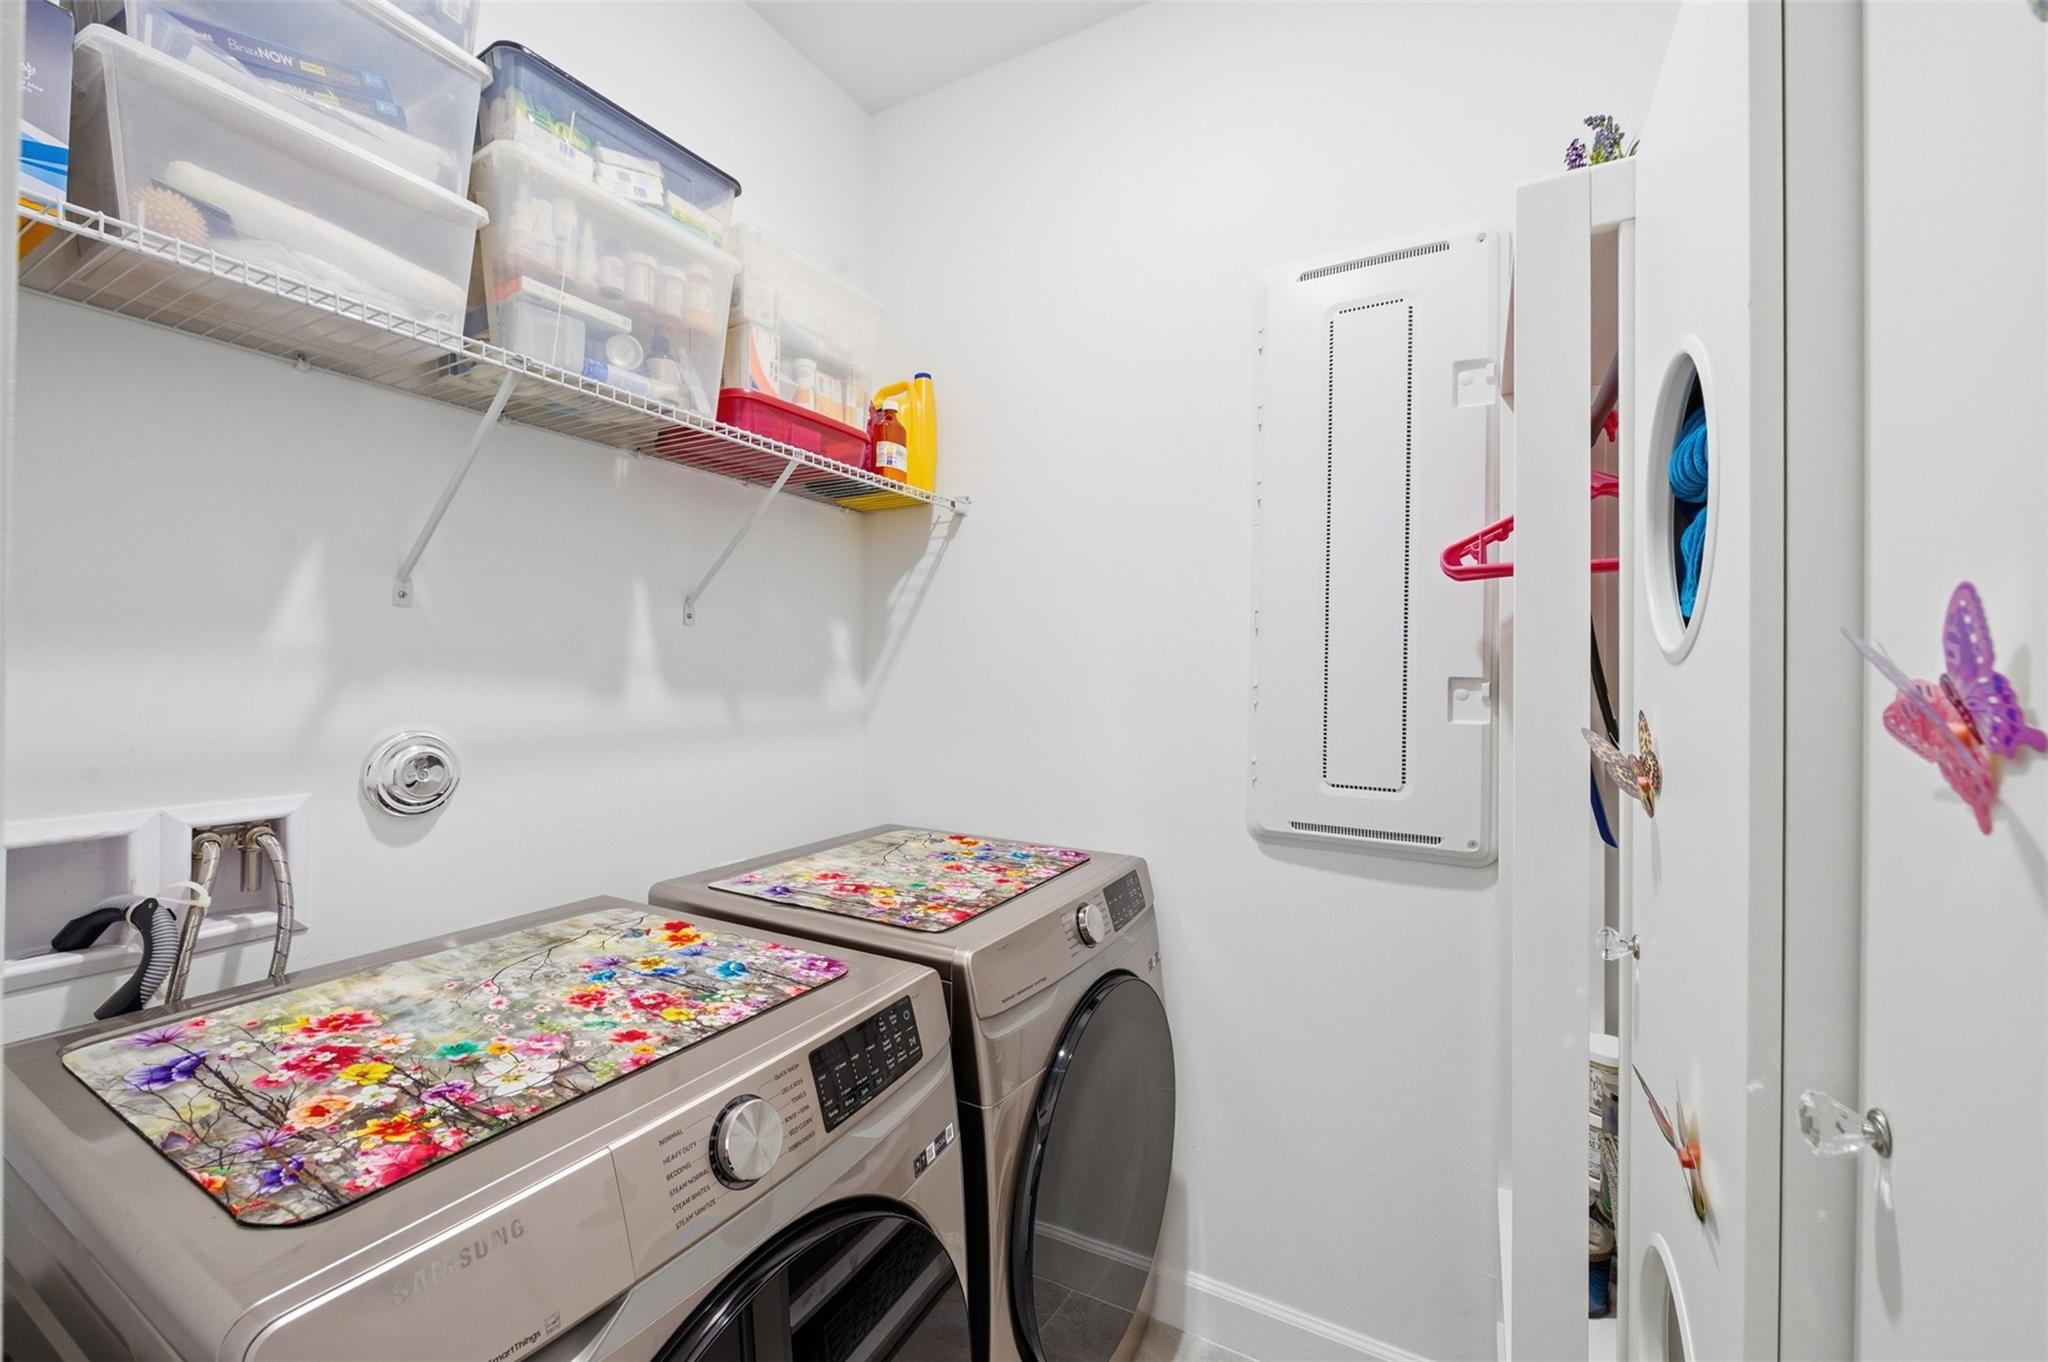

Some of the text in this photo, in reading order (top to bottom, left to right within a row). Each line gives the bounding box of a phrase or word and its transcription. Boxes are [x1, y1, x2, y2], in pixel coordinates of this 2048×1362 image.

[659, 1129, 684, 1146] NORMAL
[663, 1141, 697, 1165] HEAVY DUTY
[666, 1161, 692, 1181] BEDDING
[669, 1167, 712, 1197] STEAM NORMAL
[672, 1196, 691, 1214] STEAM
[675, 1212, 694, 1230] STEAM
[392, 1218, 525, 1305] SAMSUNG
[487, 1329, 542, 1362] martThings
